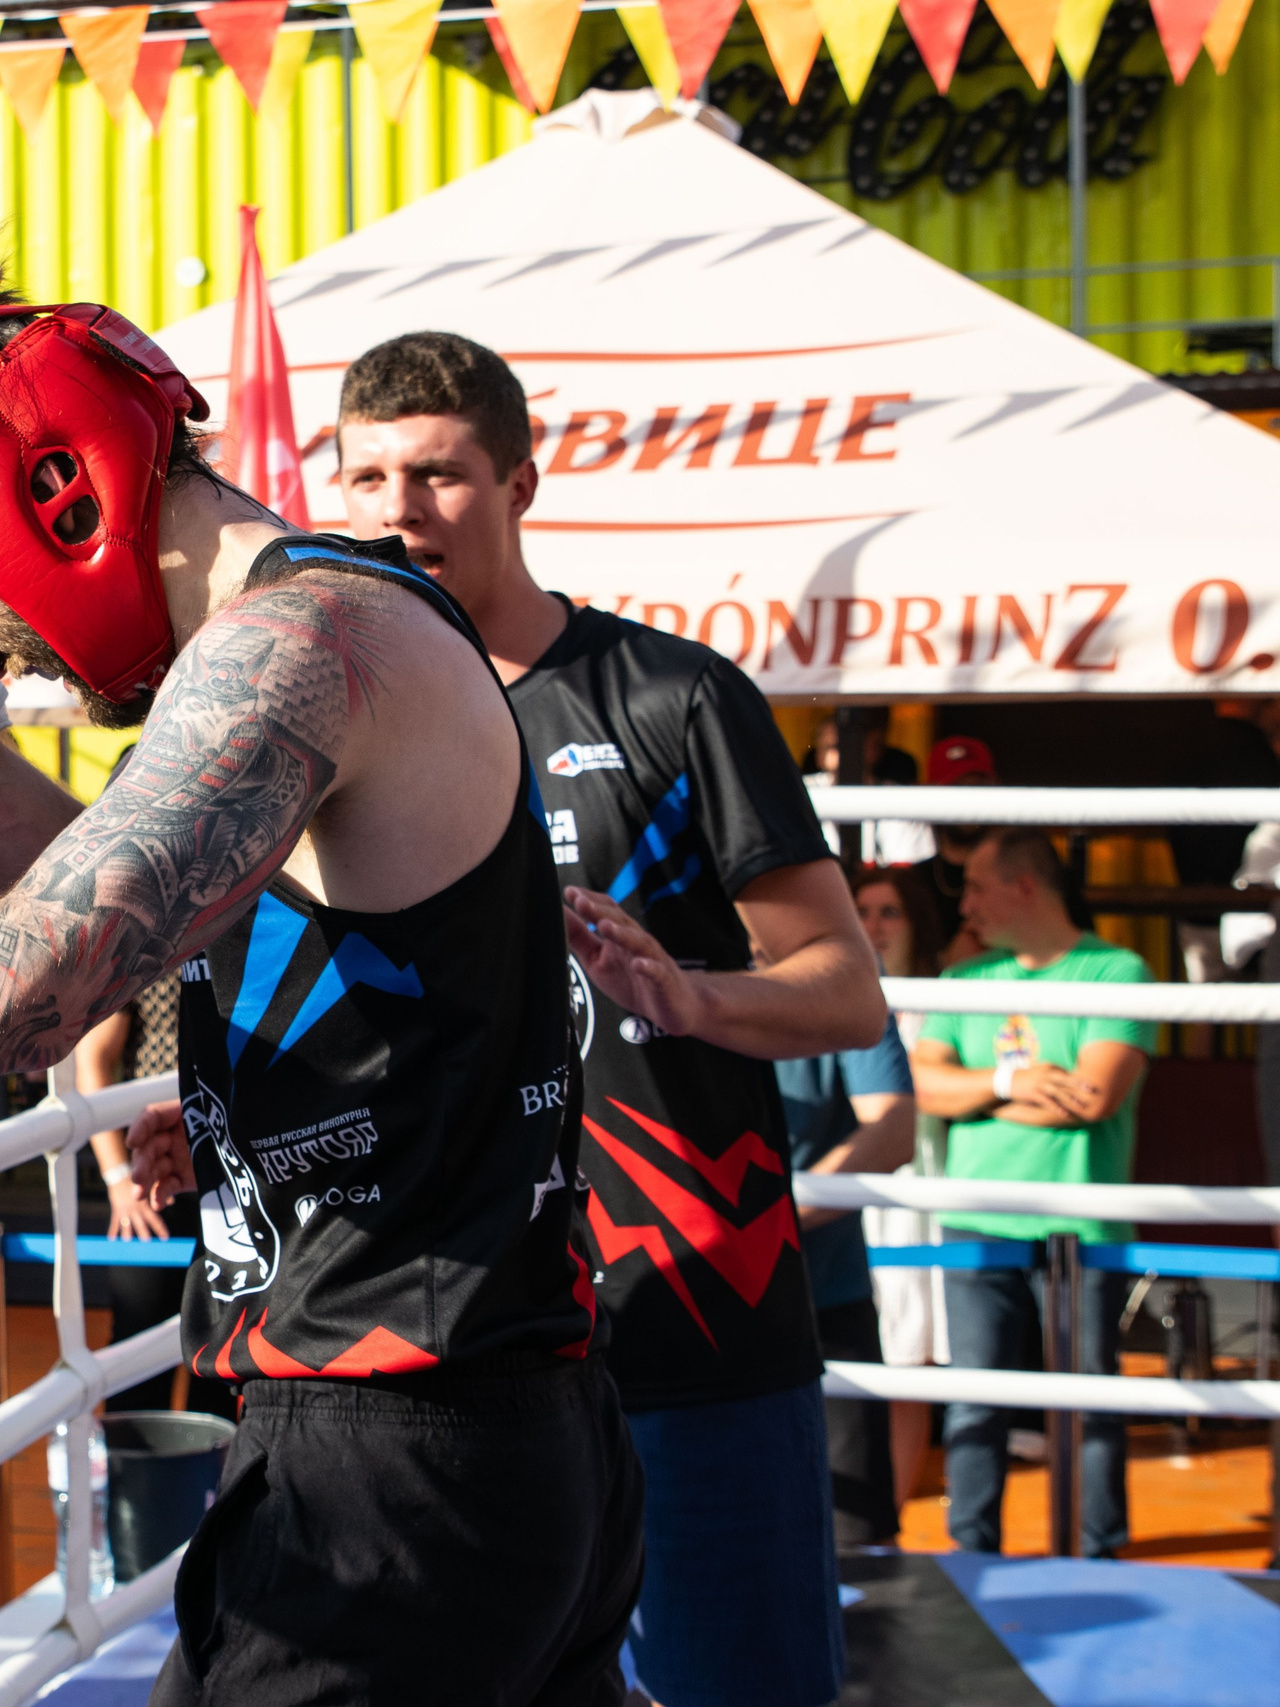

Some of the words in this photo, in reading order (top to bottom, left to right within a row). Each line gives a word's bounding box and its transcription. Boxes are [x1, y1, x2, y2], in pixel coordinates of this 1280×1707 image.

[281, 1124, 317, 1143] РУССКАЯ
[319, 1107, 370, 1132] ВИНОКУРНЯ
[256, 1121, 379, 1184] КРУТОЯР
